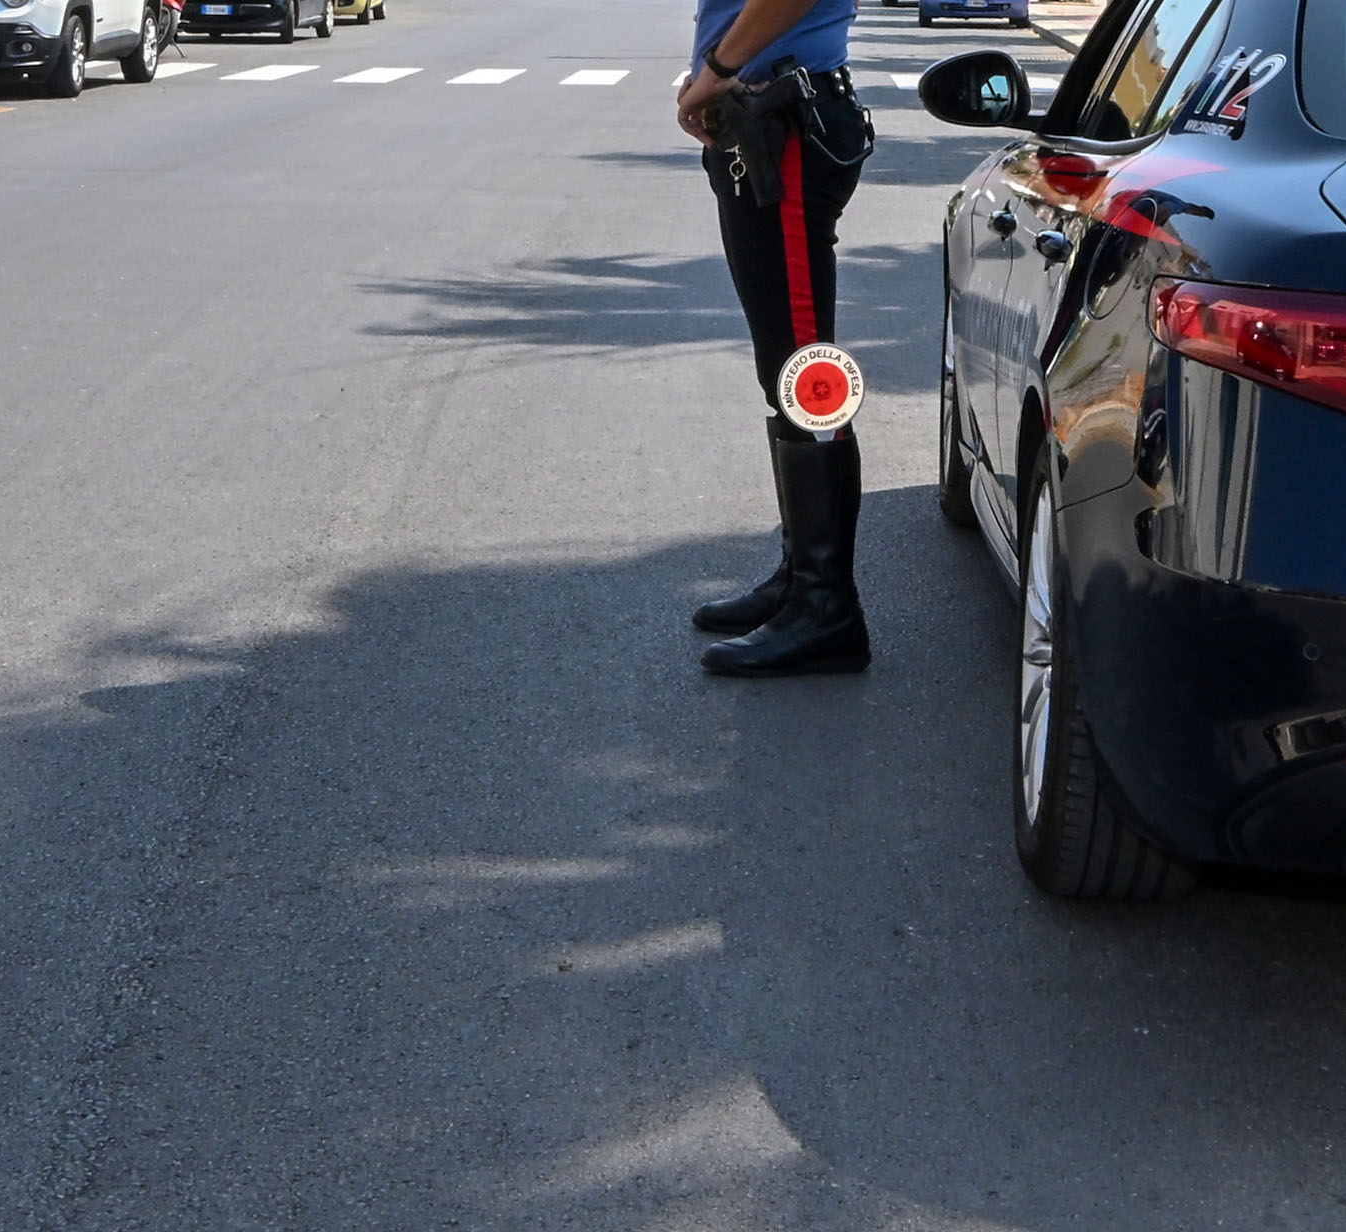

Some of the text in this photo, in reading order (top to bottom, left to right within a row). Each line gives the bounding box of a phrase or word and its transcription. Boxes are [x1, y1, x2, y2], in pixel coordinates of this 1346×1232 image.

[1194, 46, 1287, 121] 112
[781, 348, 861, 408] MINISTERO DELLA DIFESA
[805, 412, 848, 427] CARABINIERI
